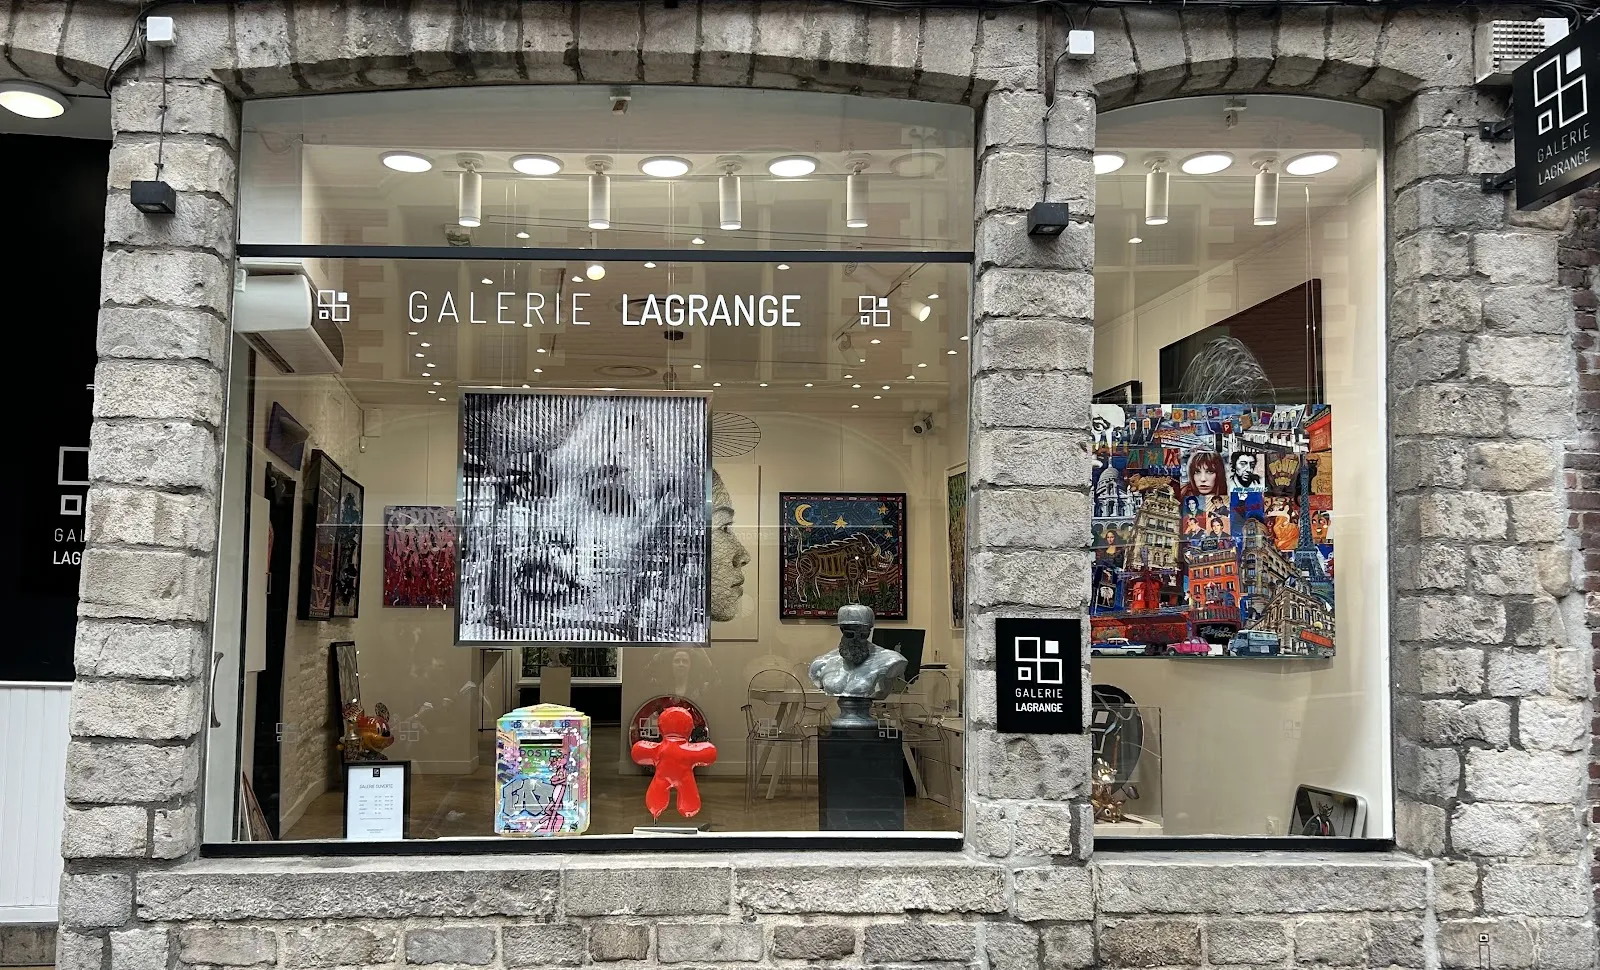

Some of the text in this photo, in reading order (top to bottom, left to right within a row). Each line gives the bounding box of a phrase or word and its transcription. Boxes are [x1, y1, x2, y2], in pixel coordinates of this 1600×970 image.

[1537, 122, 1591, 164] GALERIE
[1538, 146, 1591, 186] LAGRANGE
[408, 290, 801, 327] GALERIE LAGRANGE
[1015, 688, 1063, 699] GALERIE
[1015, 702, 1063, 713] LAGRANGE
[519, 748, 563, 758] POSTES
